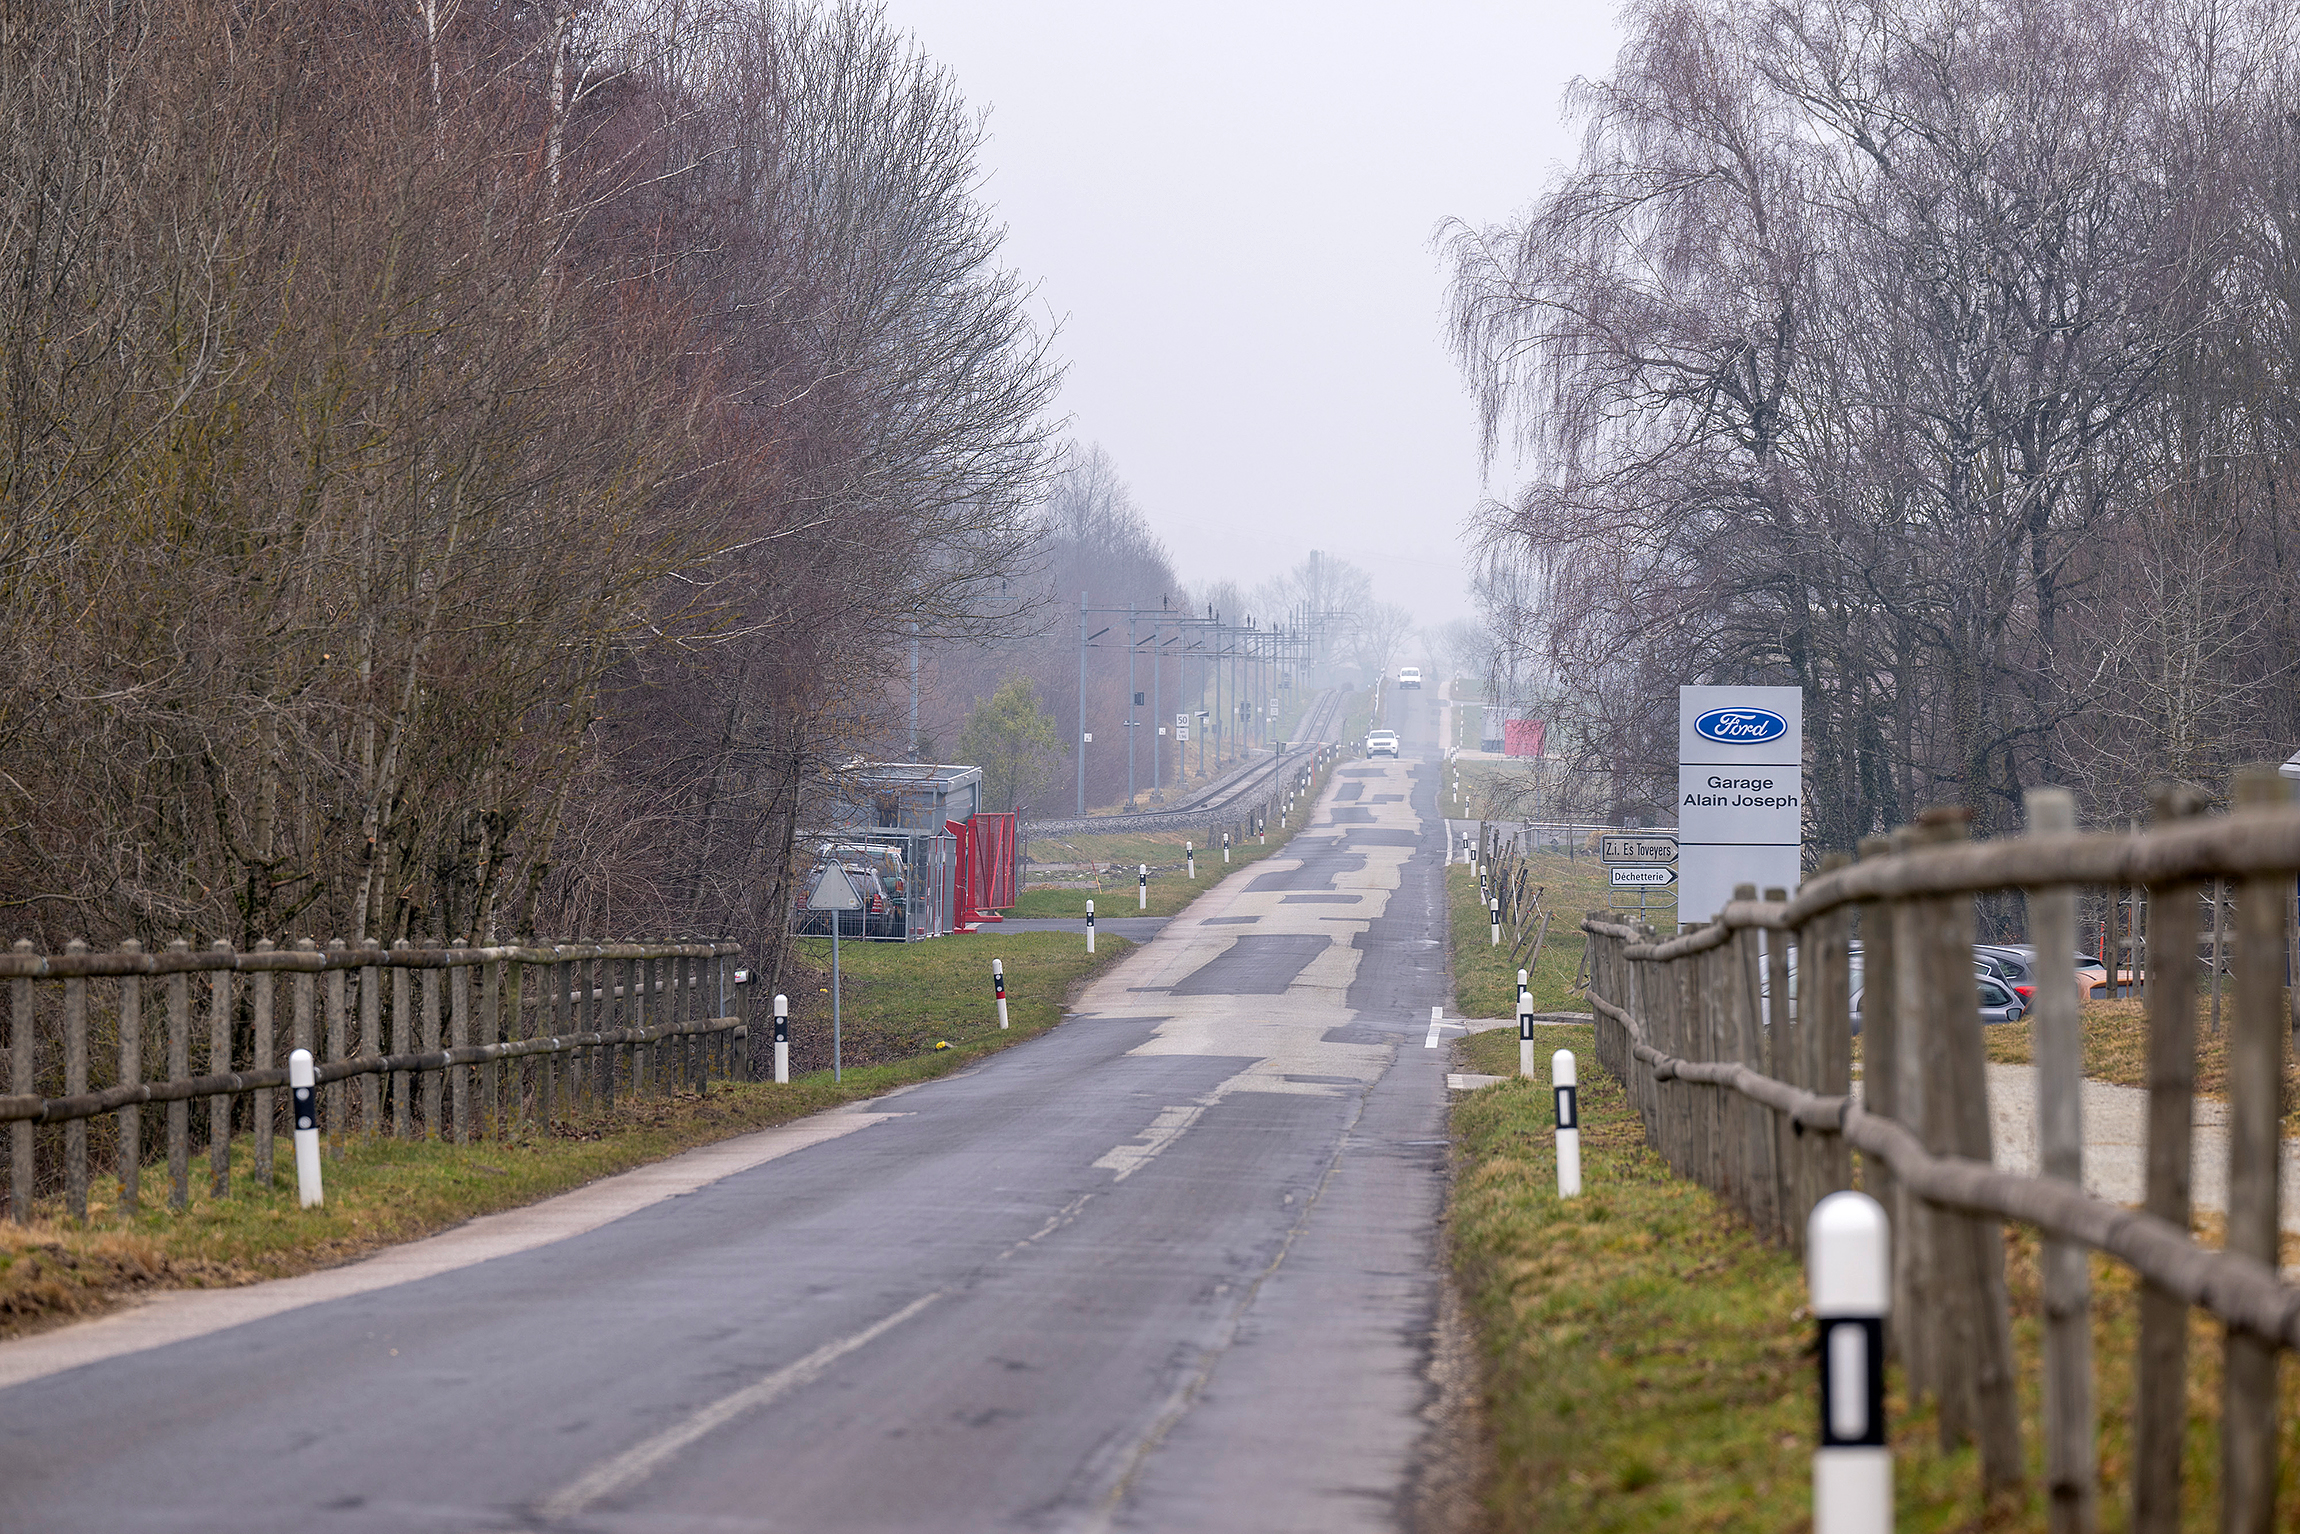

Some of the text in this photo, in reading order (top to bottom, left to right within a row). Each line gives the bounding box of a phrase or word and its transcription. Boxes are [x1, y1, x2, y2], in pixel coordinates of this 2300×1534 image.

[1178, 716, 1188, 724] 50
[1714, 714, 1769, 736] Ford
[1707, 776, 1774, 792] Garage
[1683, 794, 1798, 809] Alain Joseph
[1606, 842, 1671, 860] Z.i. Es Toveyers
[1614, 872, 1664, 881] Déchetterie
